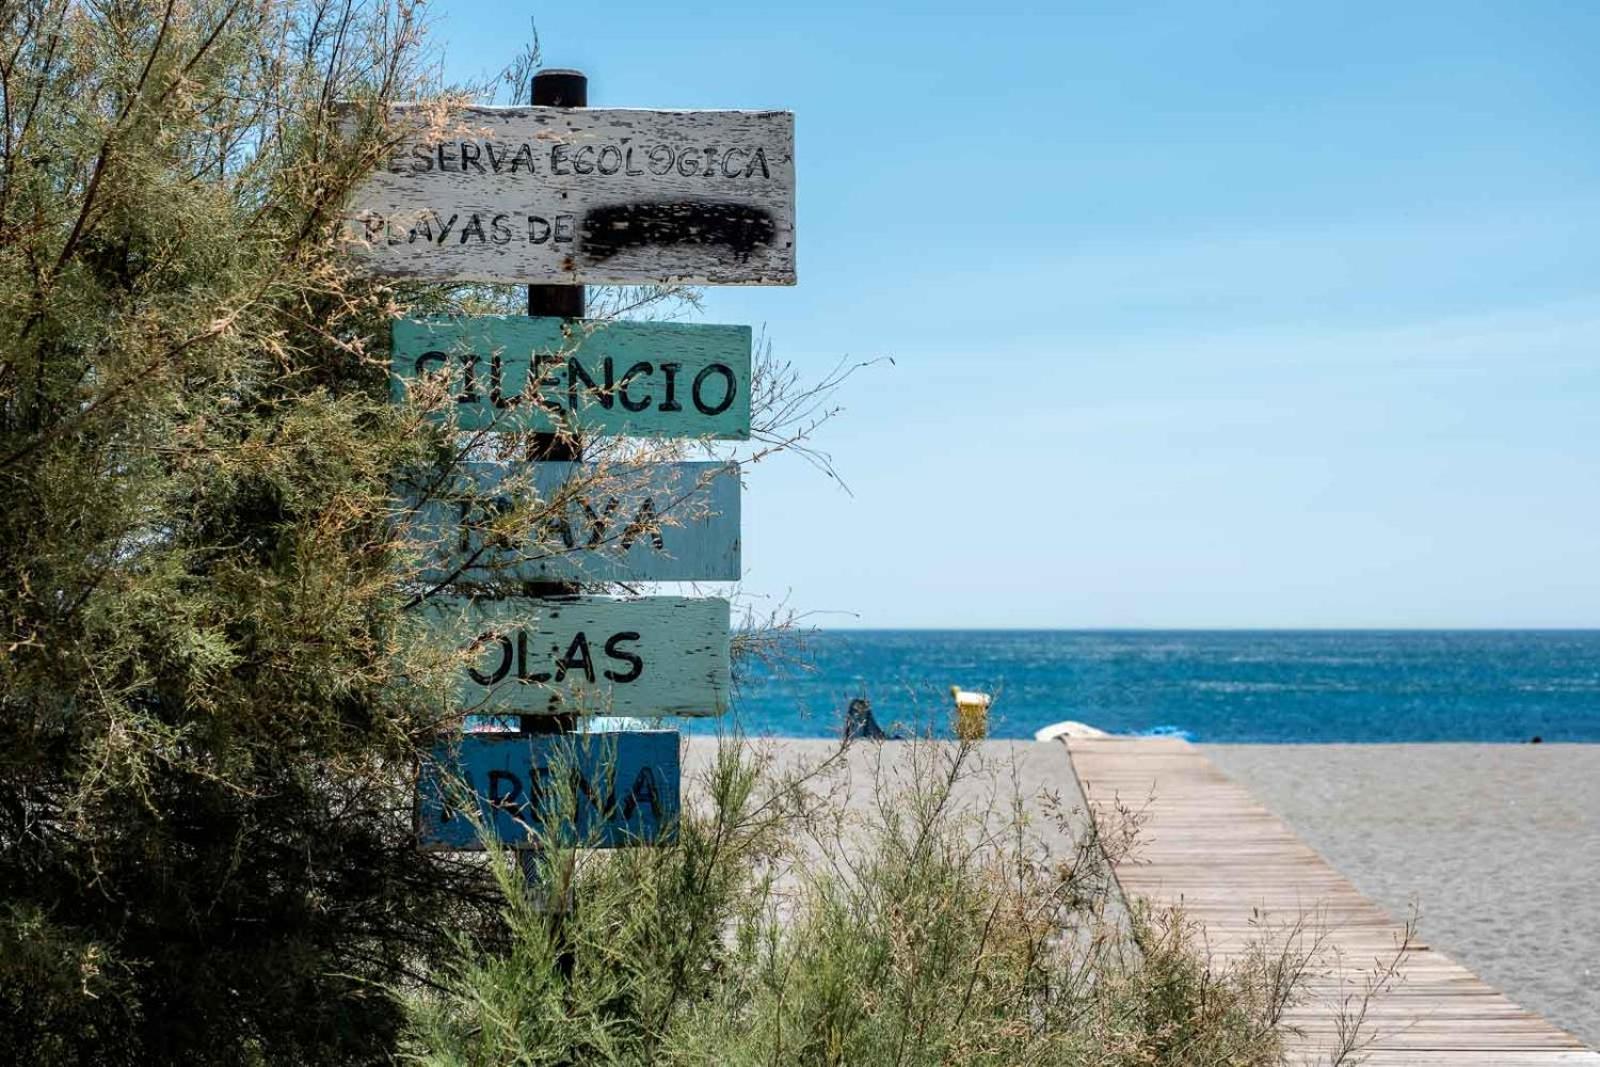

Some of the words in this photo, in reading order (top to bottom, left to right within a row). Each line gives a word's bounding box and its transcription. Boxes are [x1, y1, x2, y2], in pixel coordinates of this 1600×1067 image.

[378, 142, 536, 174] ESERVA
[363, 211, 512, 245] PLAYAS
[527, 214, 573, 245] DE
[467, 631, 643, 685] OLAS
